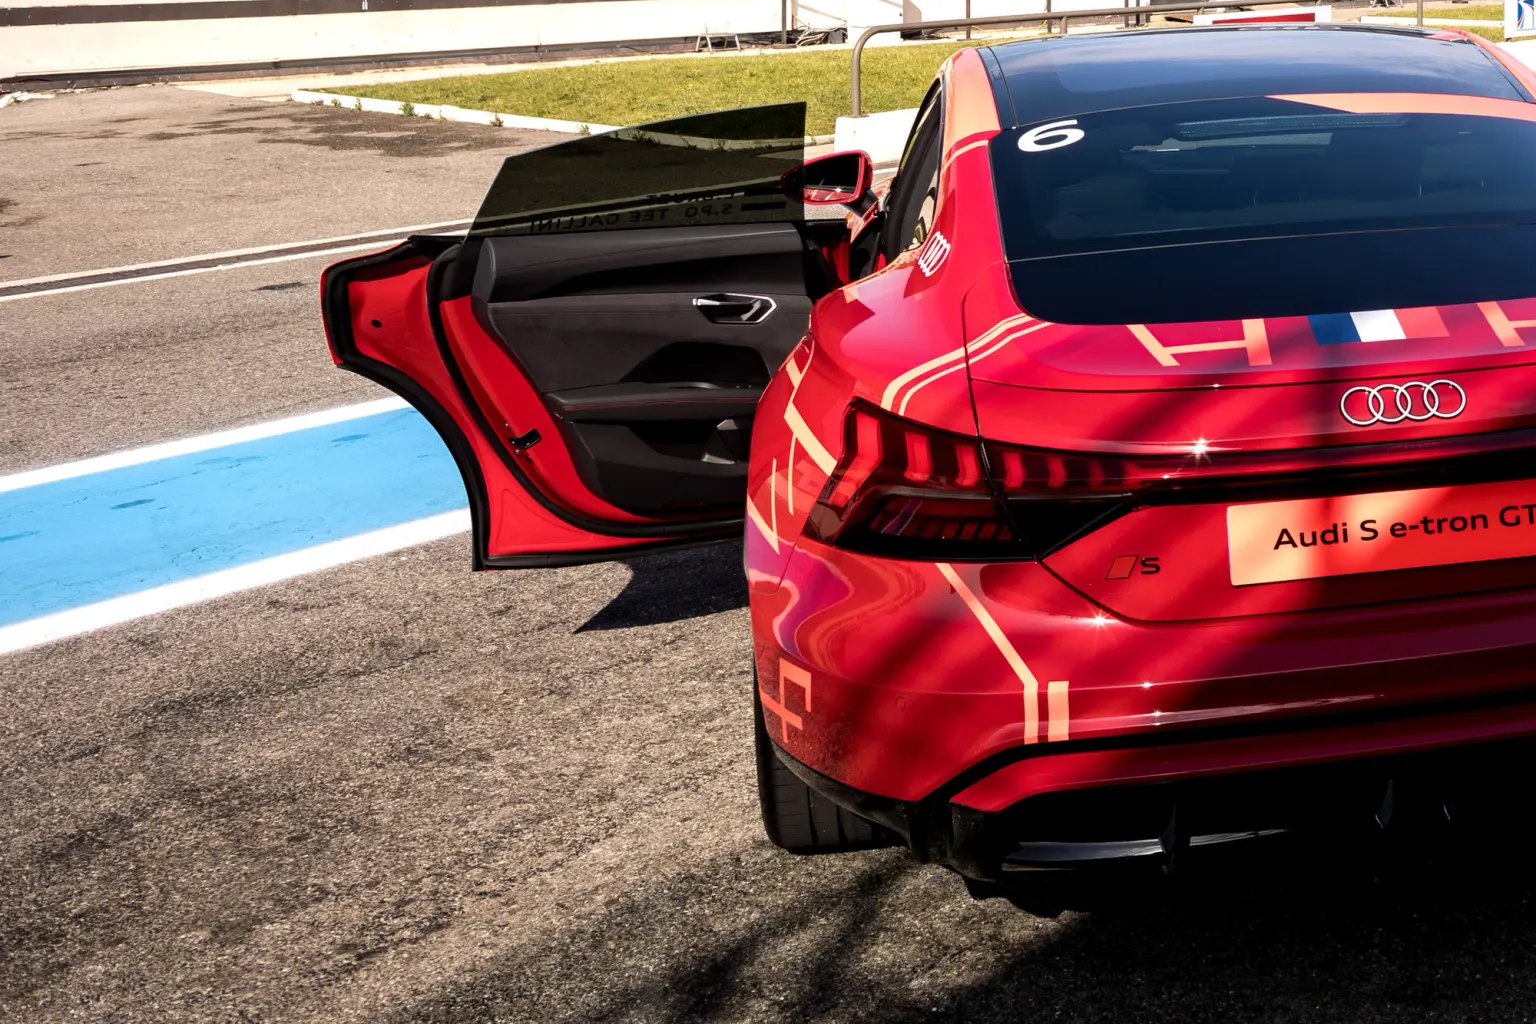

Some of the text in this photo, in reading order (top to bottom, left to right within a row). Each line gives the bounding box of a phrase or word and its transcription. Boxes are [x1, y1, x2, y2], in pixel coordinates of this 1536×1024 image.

[1017, 119, 1085, 153] 6
[1273, 522, 1349, 550] Audi
[1360, 519, 1379, 541] S
[1389, 511, 1489, 538] e-tron
[1141, 557, 1160, 574] S
